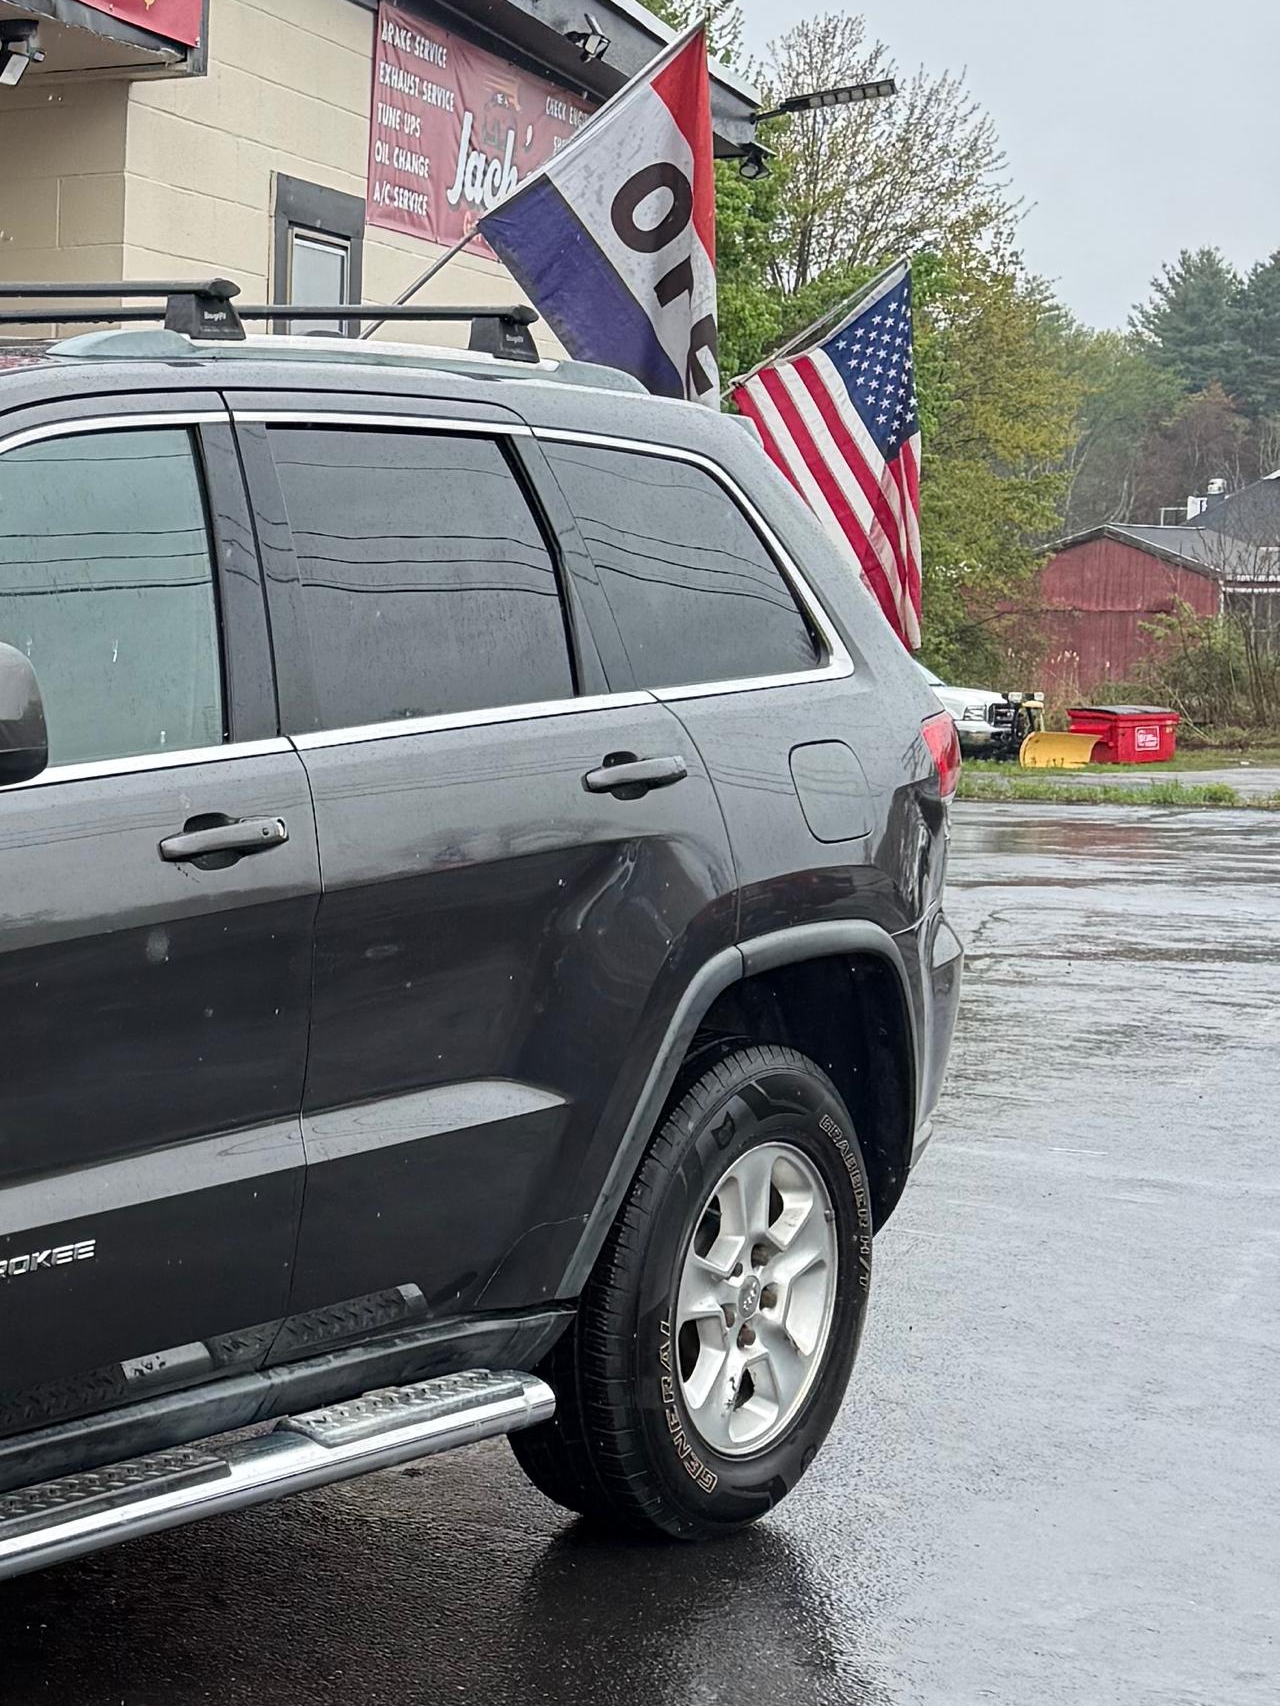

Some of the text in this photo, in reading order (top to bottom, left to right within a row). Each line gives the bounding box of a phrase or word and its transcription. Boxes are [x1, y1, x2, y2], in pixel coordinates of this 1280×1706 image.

[381, 20, 447, 69] BRAKE SERVICE
[379, 61, 455, 113] EXHAUST SERVICE
[377, 102, 421, 138] TUNE UPS
[375, 140, 430, 179] OIL CHANGE
[373, 181, 429, 216] A/C SERVICE
[659, 1305, 718, 1494] GENERAL
